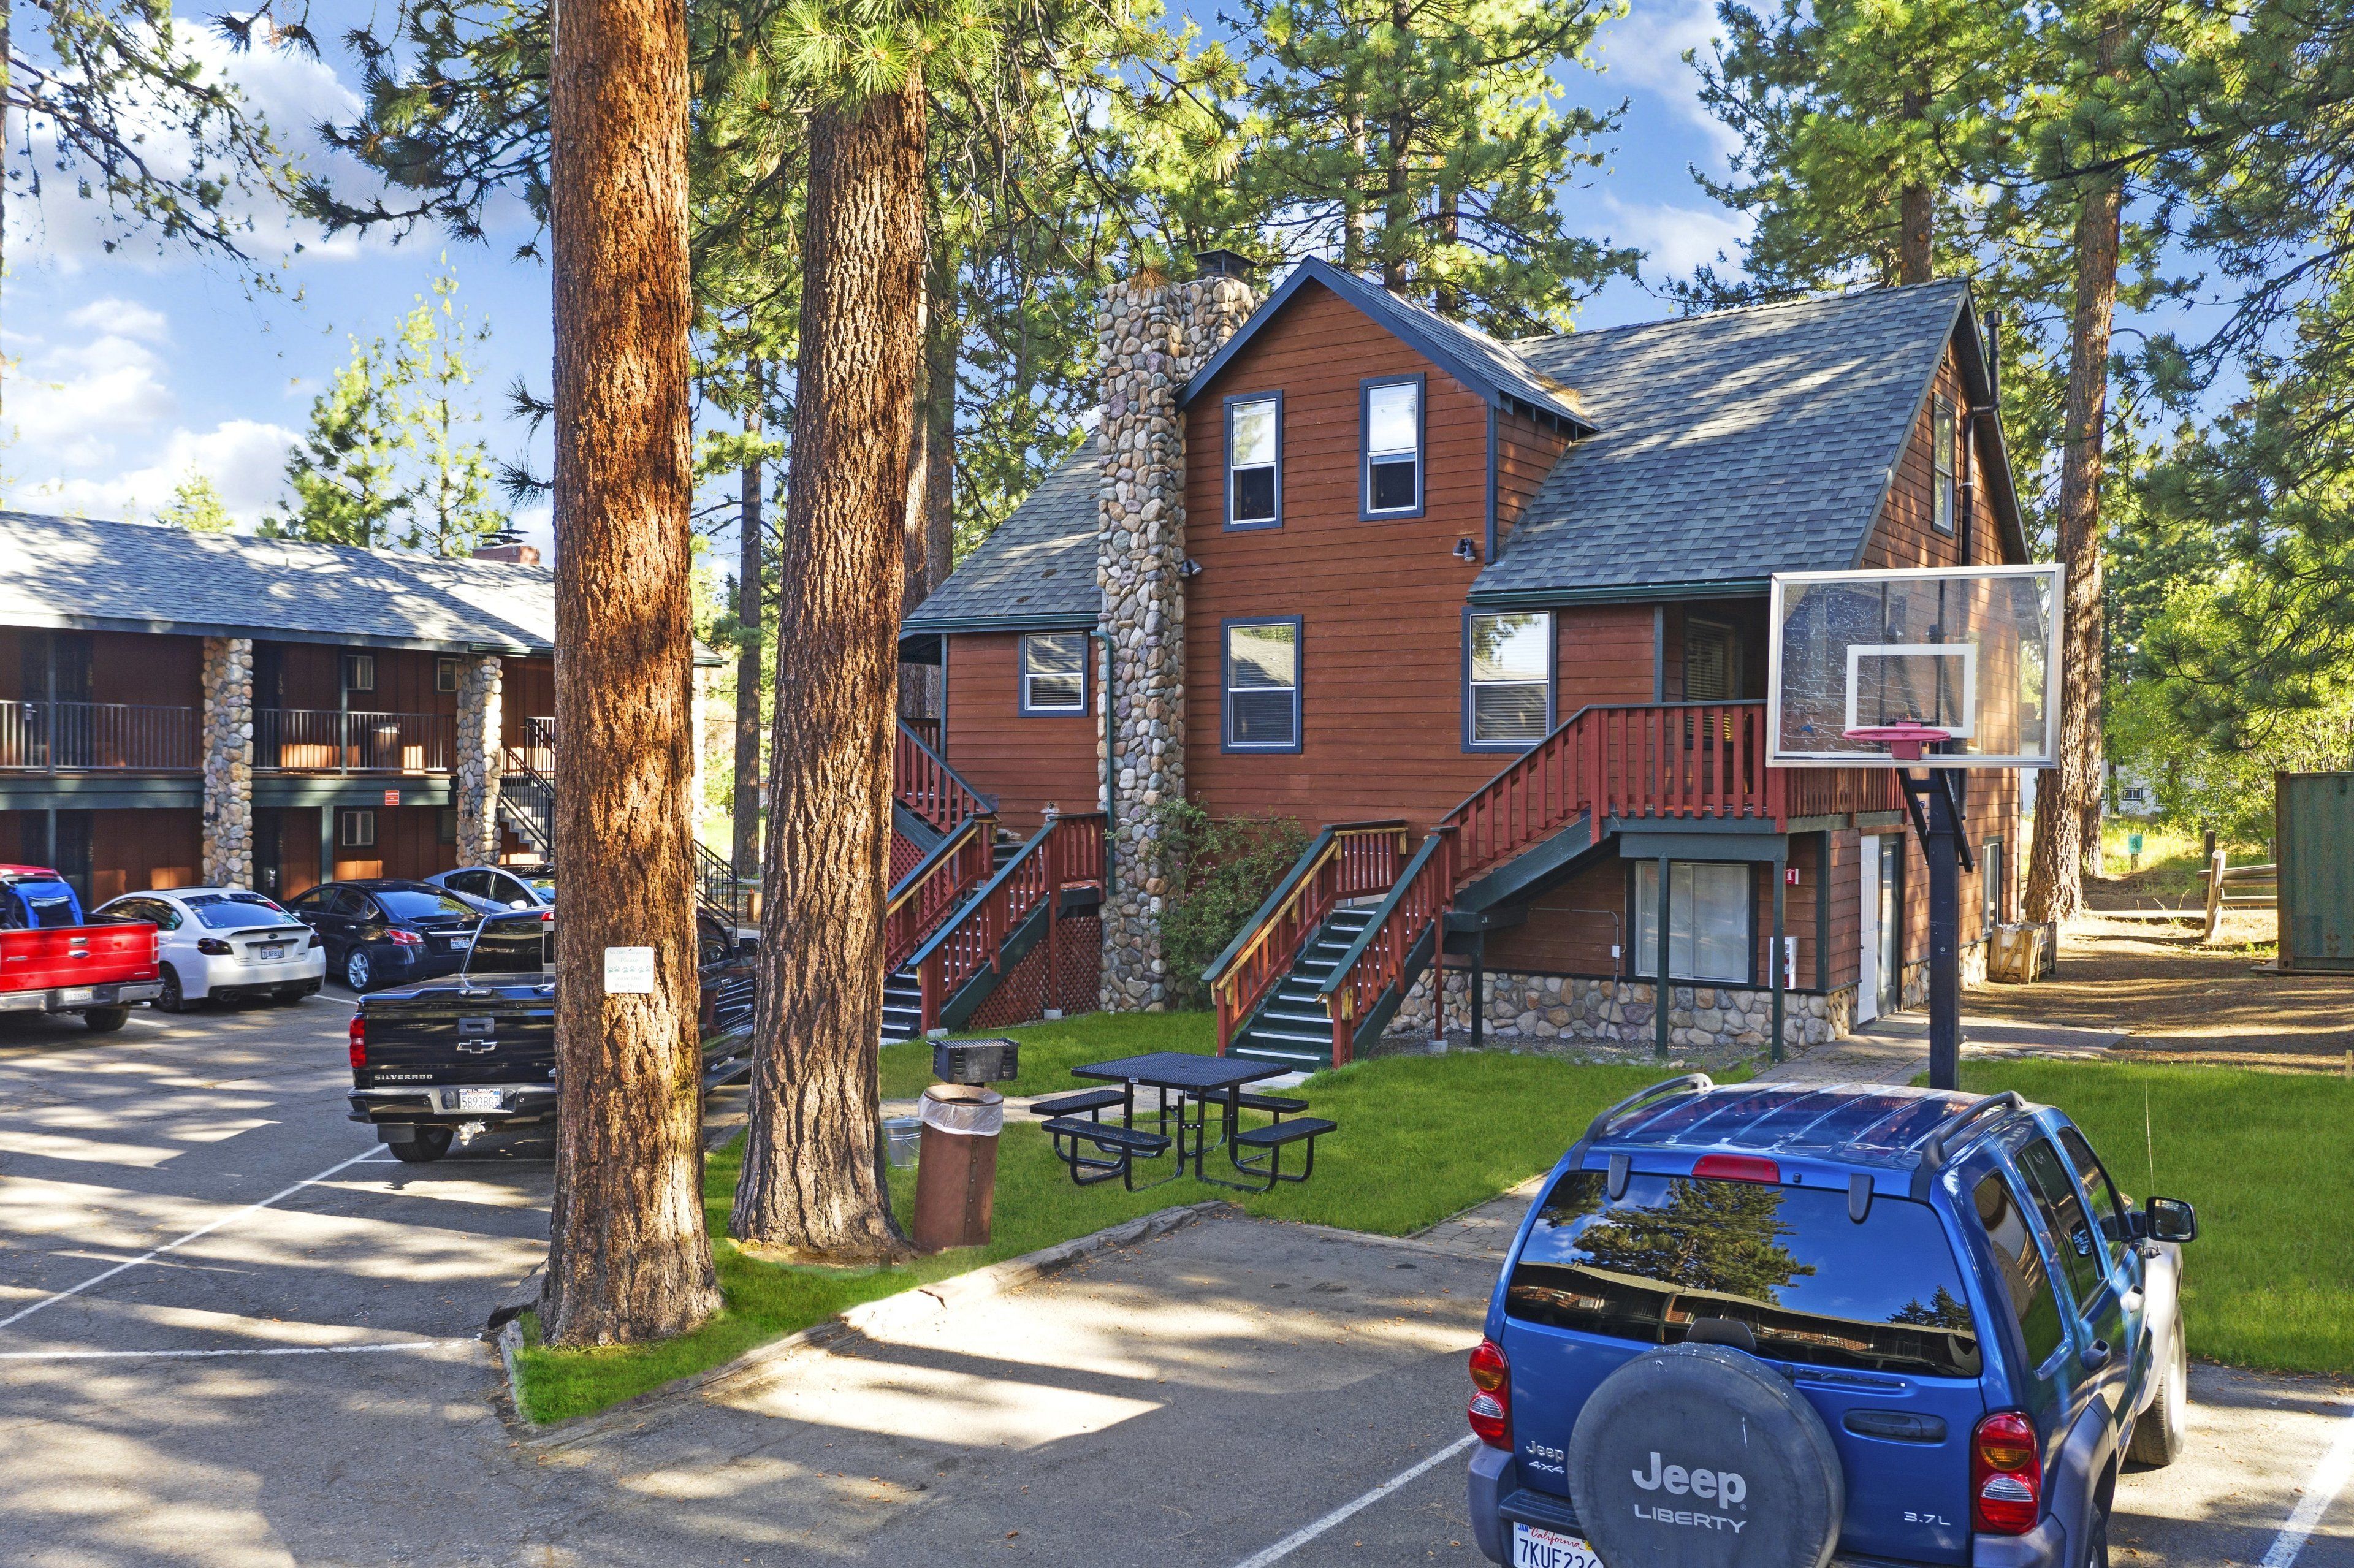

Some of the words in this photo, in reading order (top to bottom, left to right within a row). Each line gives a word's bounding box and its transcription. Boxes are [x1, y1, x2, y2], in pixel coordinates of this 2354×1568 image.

[1526, 1441, 1564, 1463] Jeep
[1632, 1452, 1746, 1509] Jeep
[1518, 1523, 1529, 1532] JAN
[1634, 1504, 1747, 1533] LIBERTY
[1904, 1512, 1951, 1526] 3.7L
[1531, 1526, 1586, 1551] California
